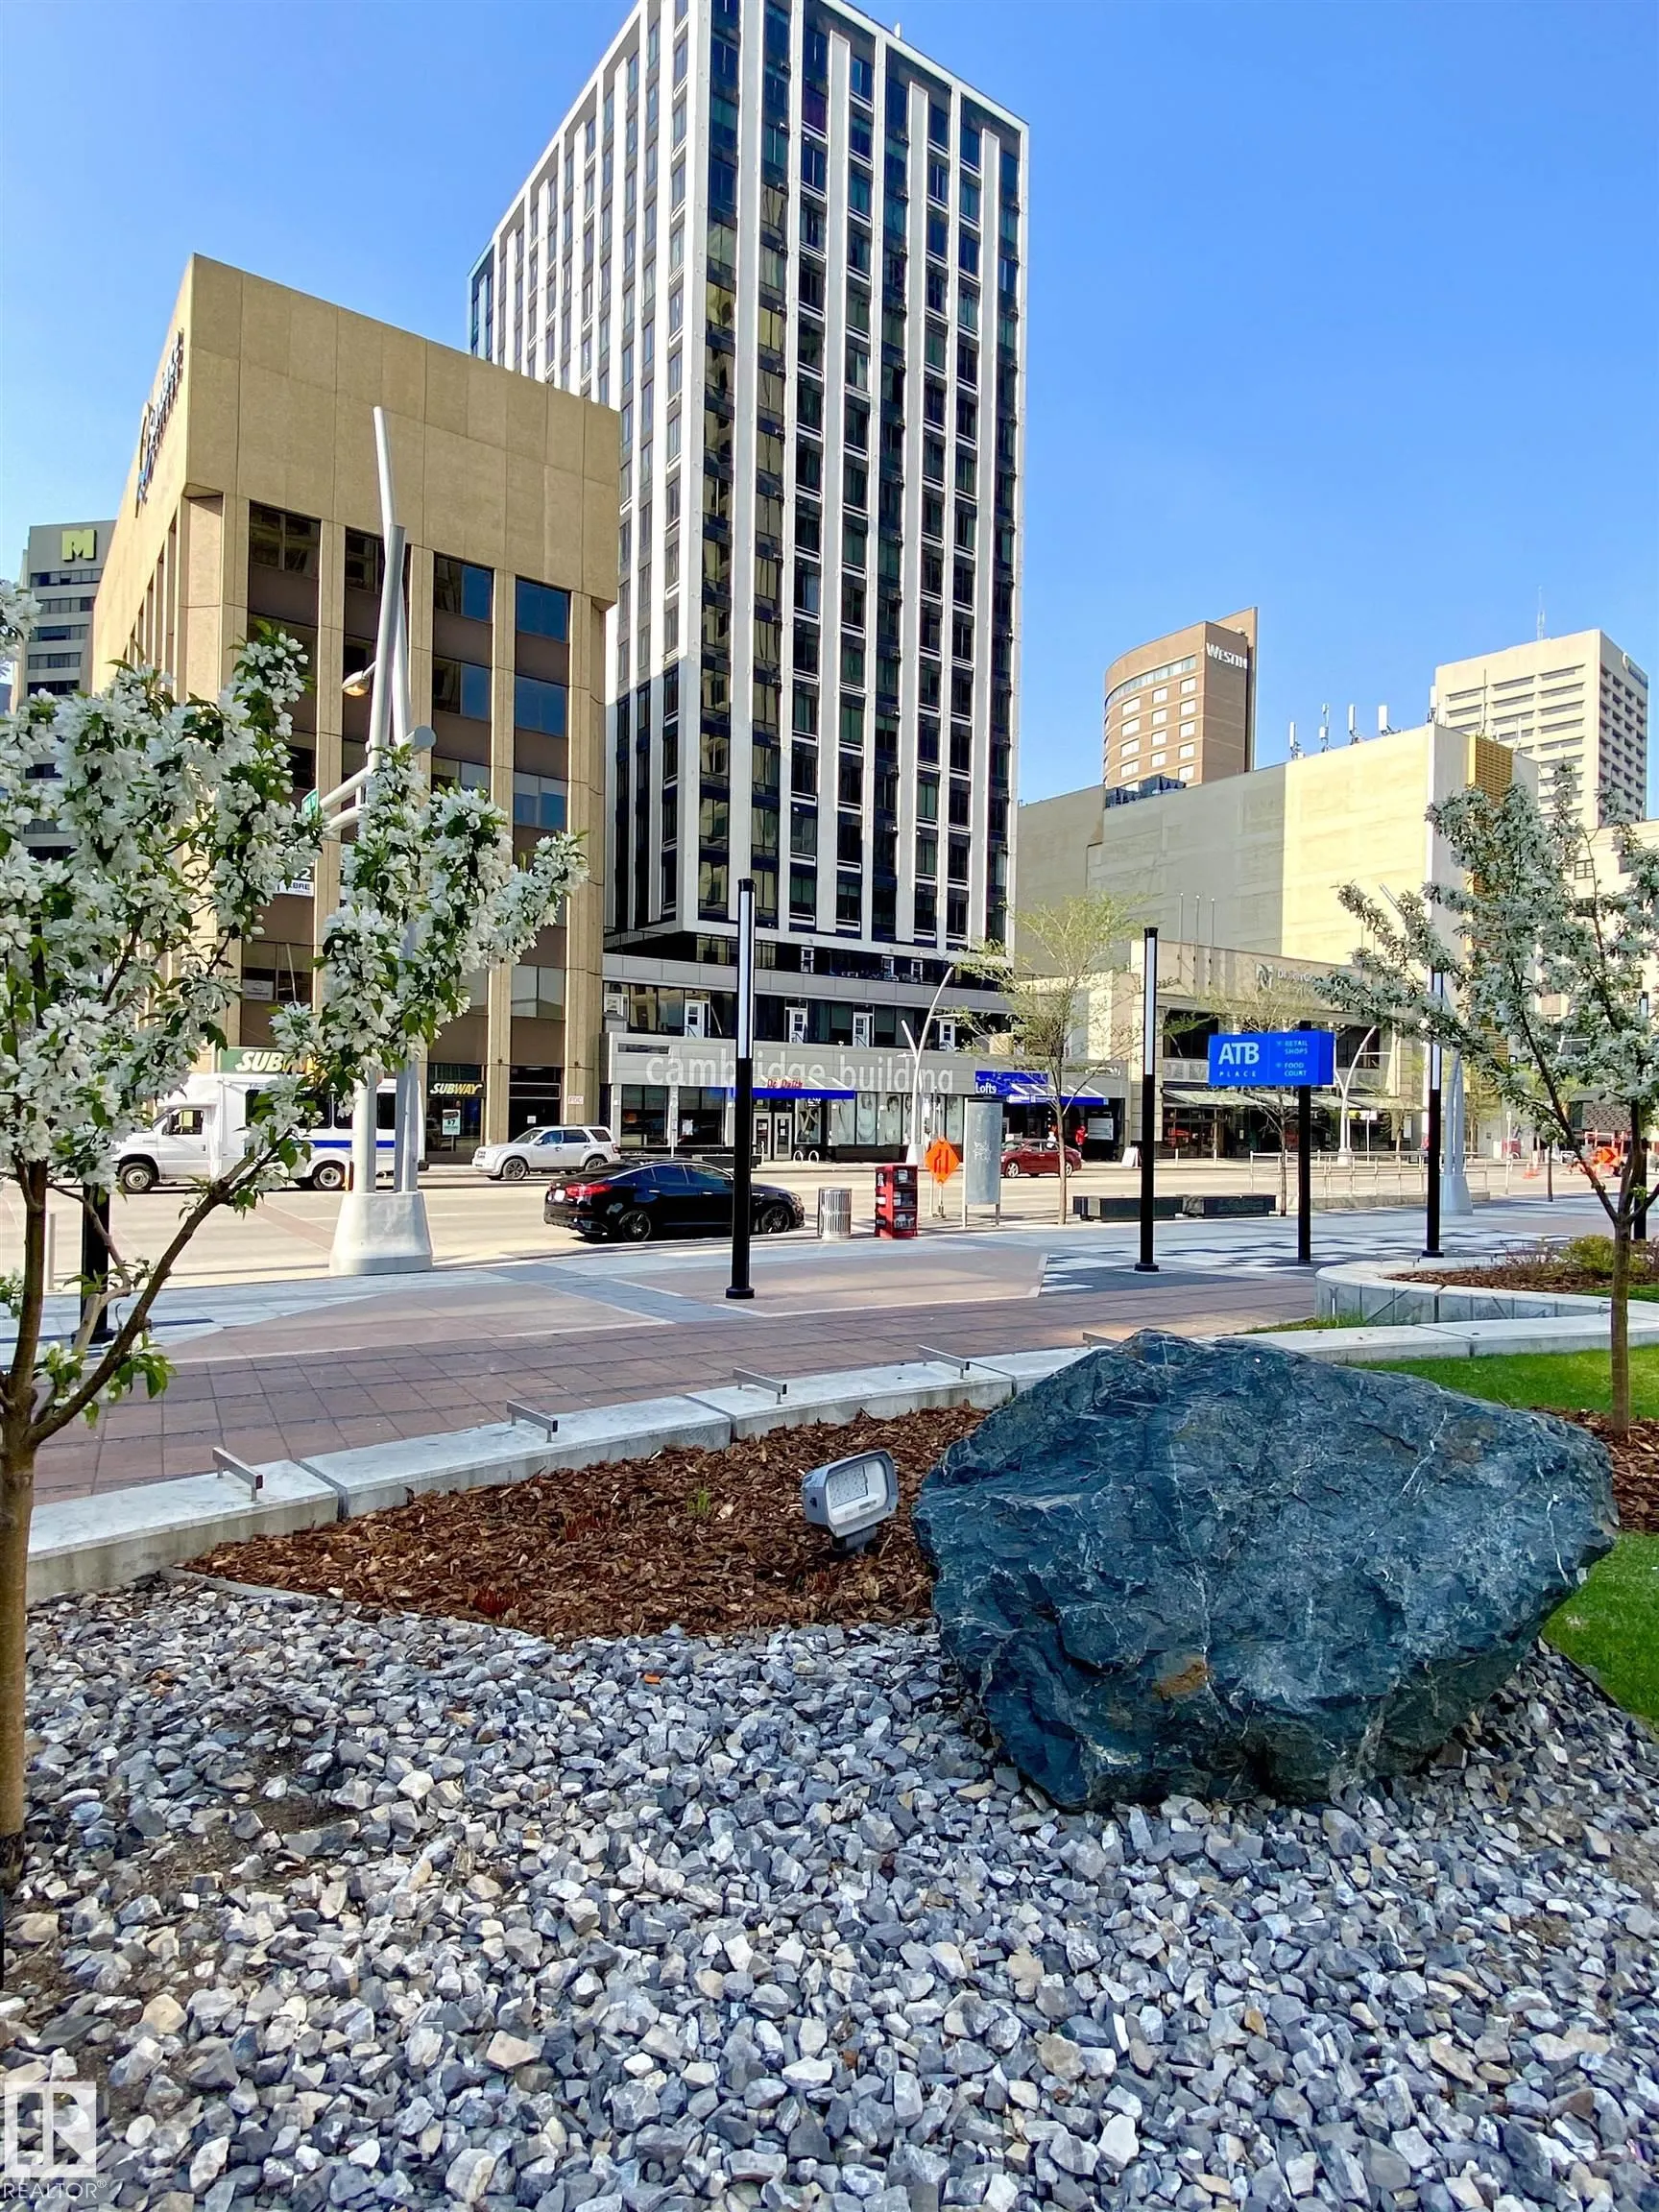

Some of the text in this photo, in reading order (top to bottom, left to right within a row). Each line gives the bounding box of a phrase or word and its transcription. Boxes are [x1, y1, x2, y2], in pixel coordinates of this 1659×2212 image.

[1218, 1042, 1260, 1065] ATB
[429, 1083, 483, 1095] SUBWAY
[975, 1082, 998, 1094] Lofts
